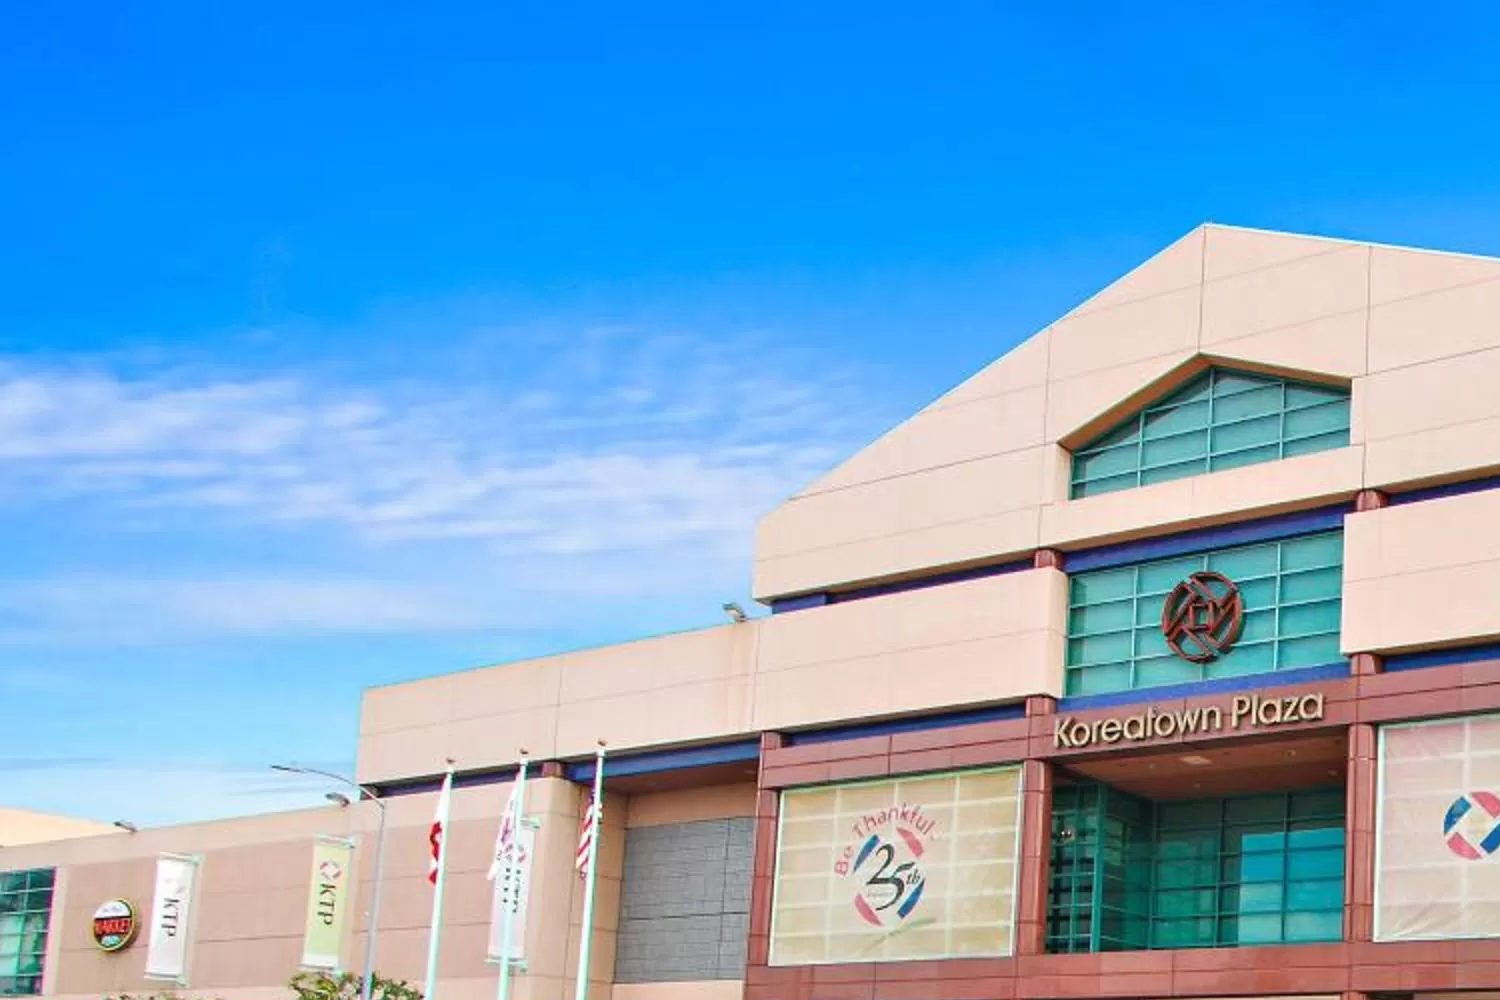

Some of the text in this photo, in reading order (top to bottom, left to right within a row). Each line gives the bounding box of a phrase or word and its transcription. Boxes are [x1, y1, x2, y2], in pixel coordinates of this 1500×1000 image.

[1054, 693, 1324, 748] Koreatown Plaza
[160, 898, 180, 937] KTP
[317, 883, 337, 925] KTP
